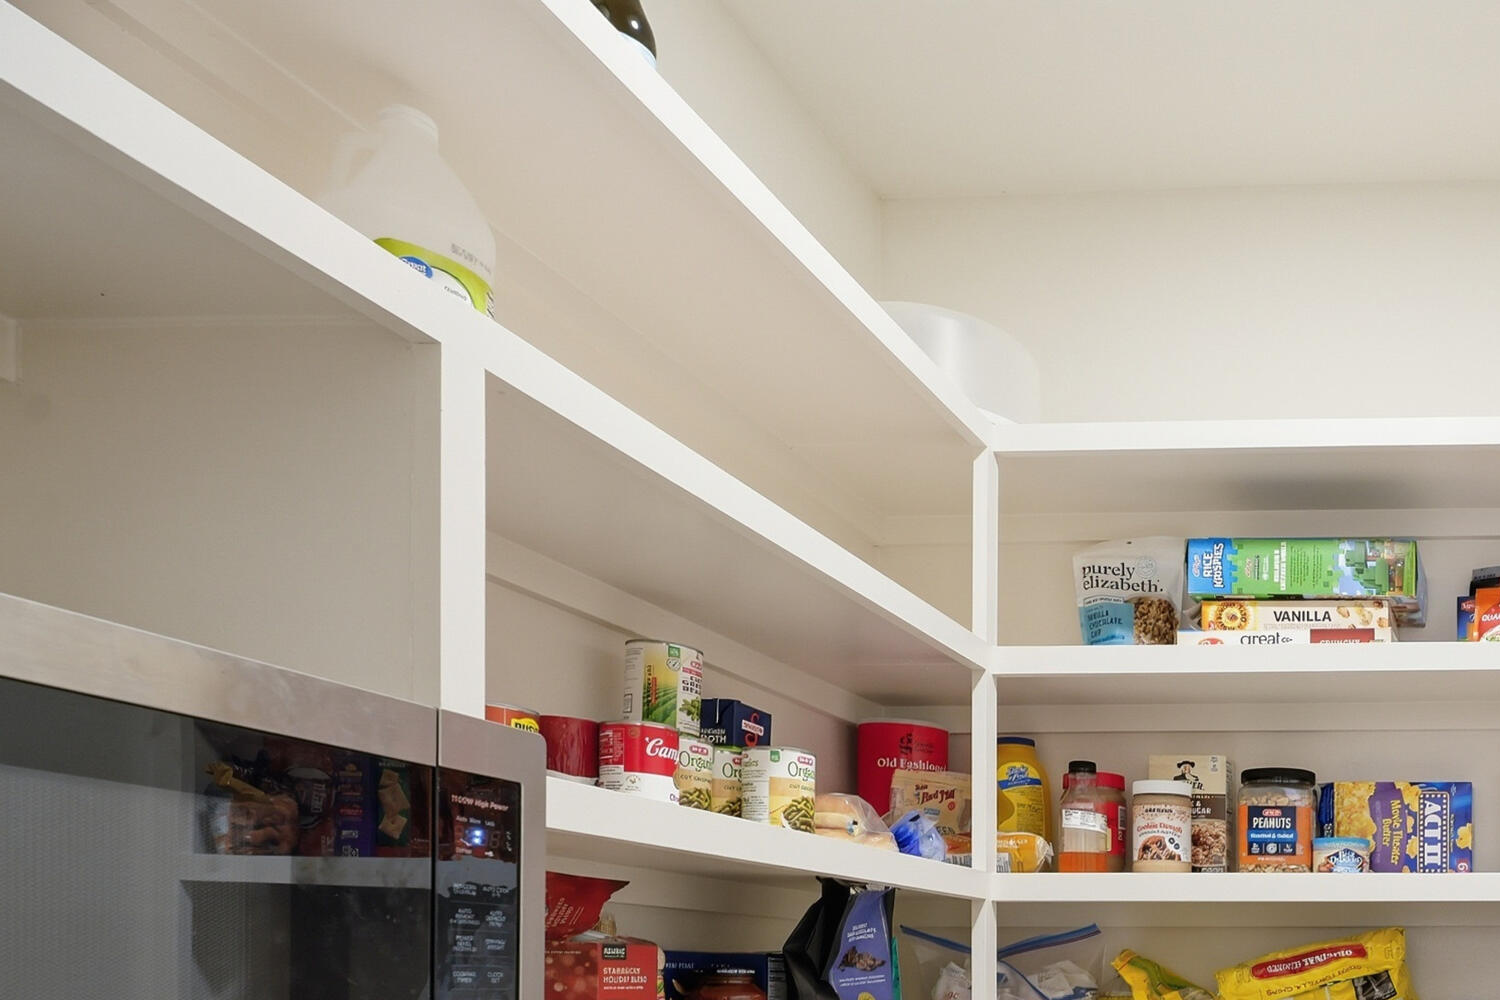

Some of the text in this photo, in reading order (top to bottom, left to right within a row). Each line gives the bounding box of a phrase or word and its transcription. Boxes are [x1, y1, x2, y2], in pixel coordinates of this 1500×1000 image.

[1082, 562, 1136, 580] purely
[1203, 551, 1214, 578] RICE
[1273, 610, 1332, 622] VANILLA
[877, 757, 897, 768] Old
[1252, 817, 1292, 829] PEANUTS
[1424, 800, 1442, 840] ACT
